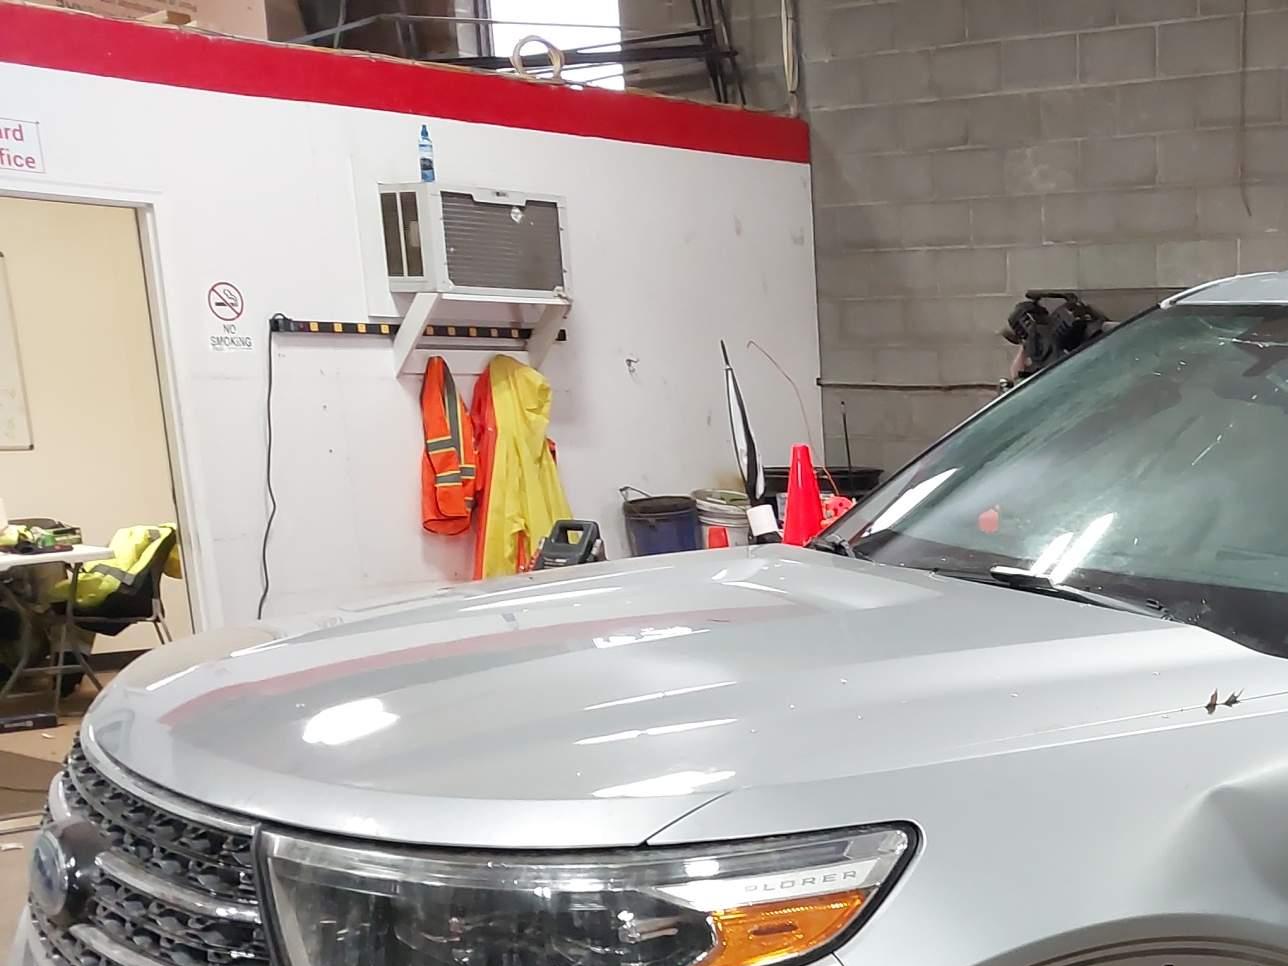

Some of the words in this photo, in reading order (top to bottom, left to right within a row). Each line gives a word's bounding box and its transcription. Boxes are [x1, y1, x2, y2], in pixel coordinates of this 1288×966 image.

[0, 123, 24, 141] rd
[223, 324, 237, 335] NO
[210, 336, 252, 348] SMOKING
